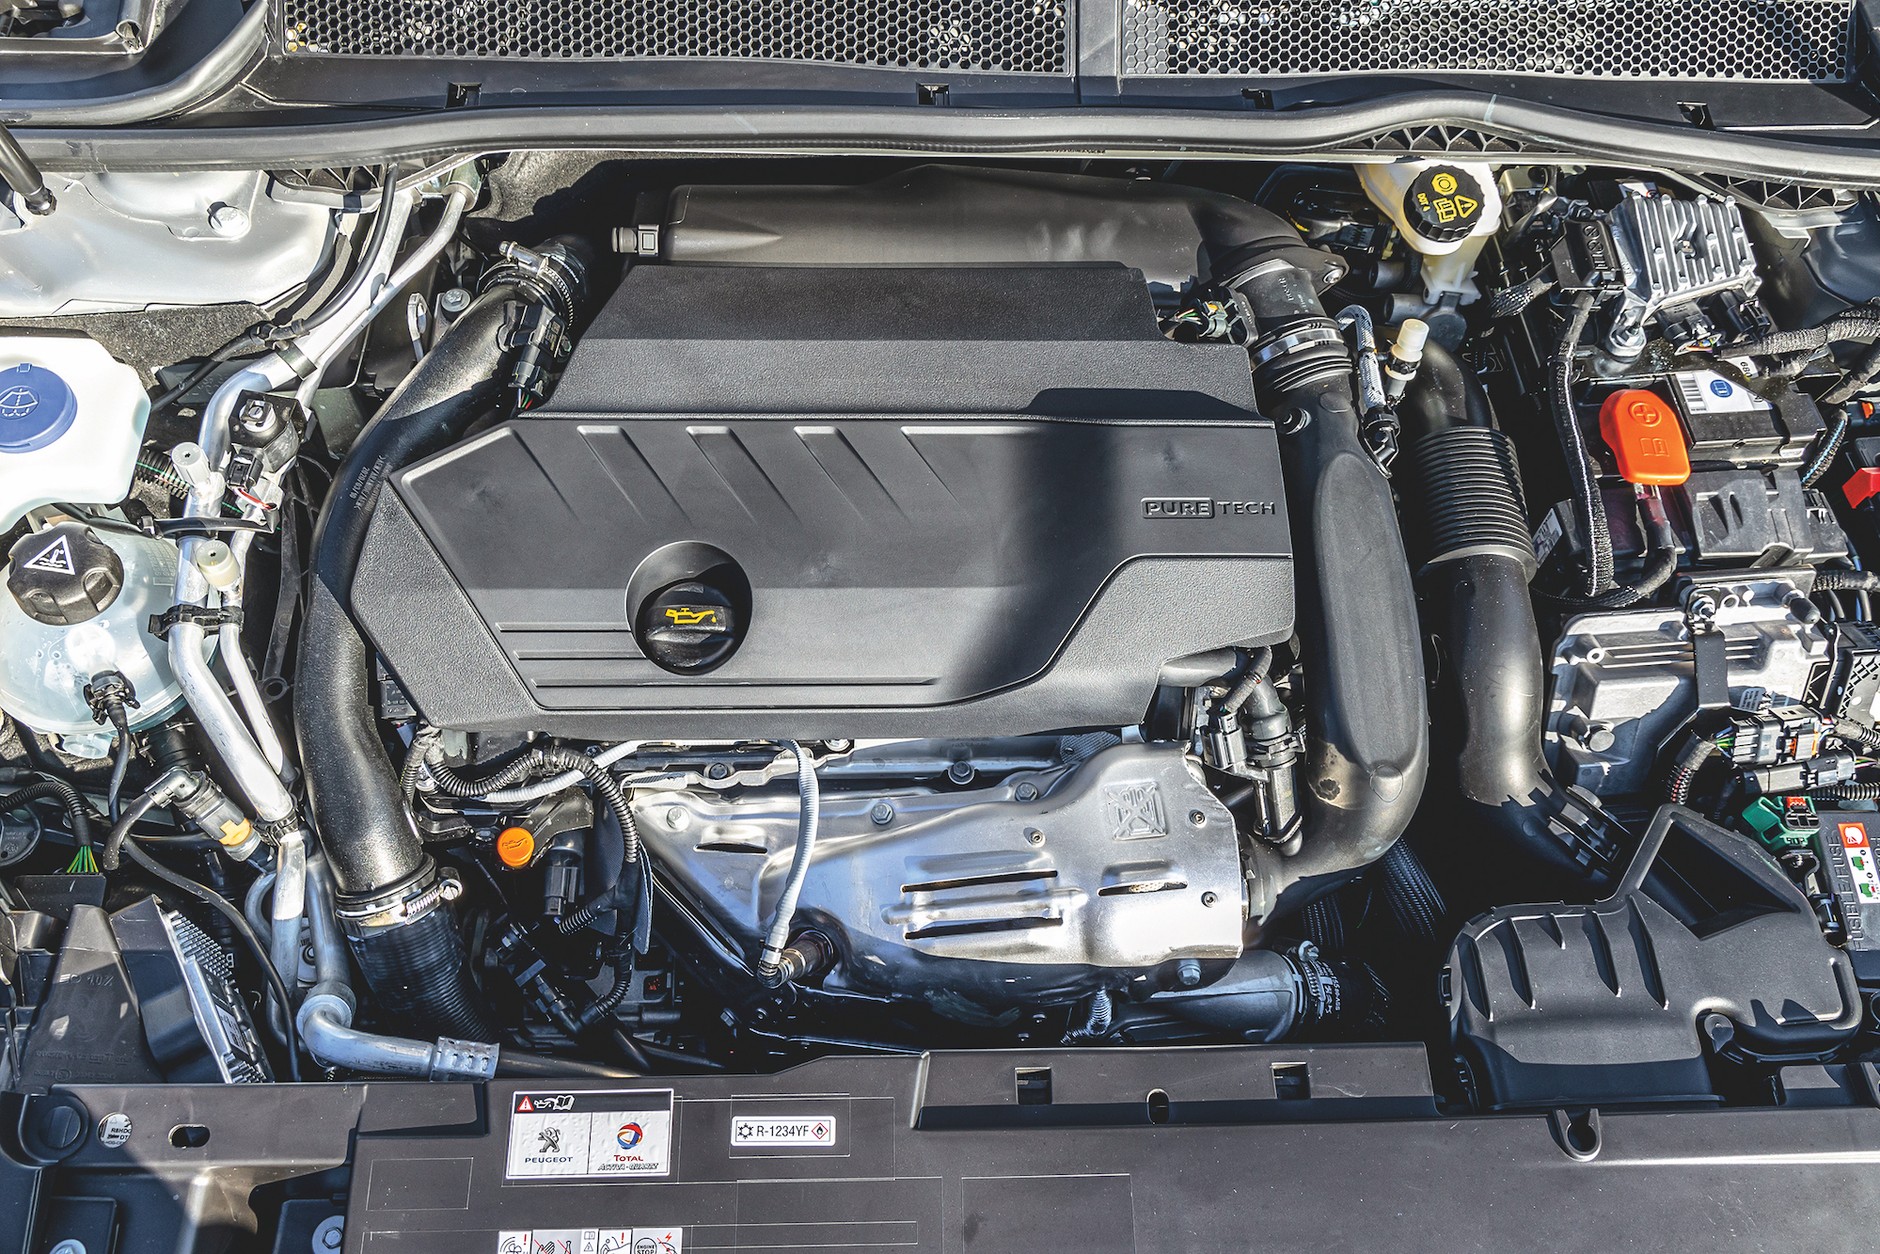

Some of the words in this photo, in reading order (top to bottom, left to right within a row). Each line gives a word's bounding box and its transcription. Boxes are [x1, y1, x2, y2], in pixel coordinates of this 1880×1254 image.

[1416, 192, 1429, 206] DOT
[1145, 501, 1210, 516] PURE
[1216, 501, 1276, 515] TECH
[1825, 835, 1868, 952] FUSIBLE/FUSE
[756, 1125, 810, 1137] R-1234YF
[524, 1156, 574, 1164] PEUGEOT
[613, 1154, 644, 1162] TOTAL
